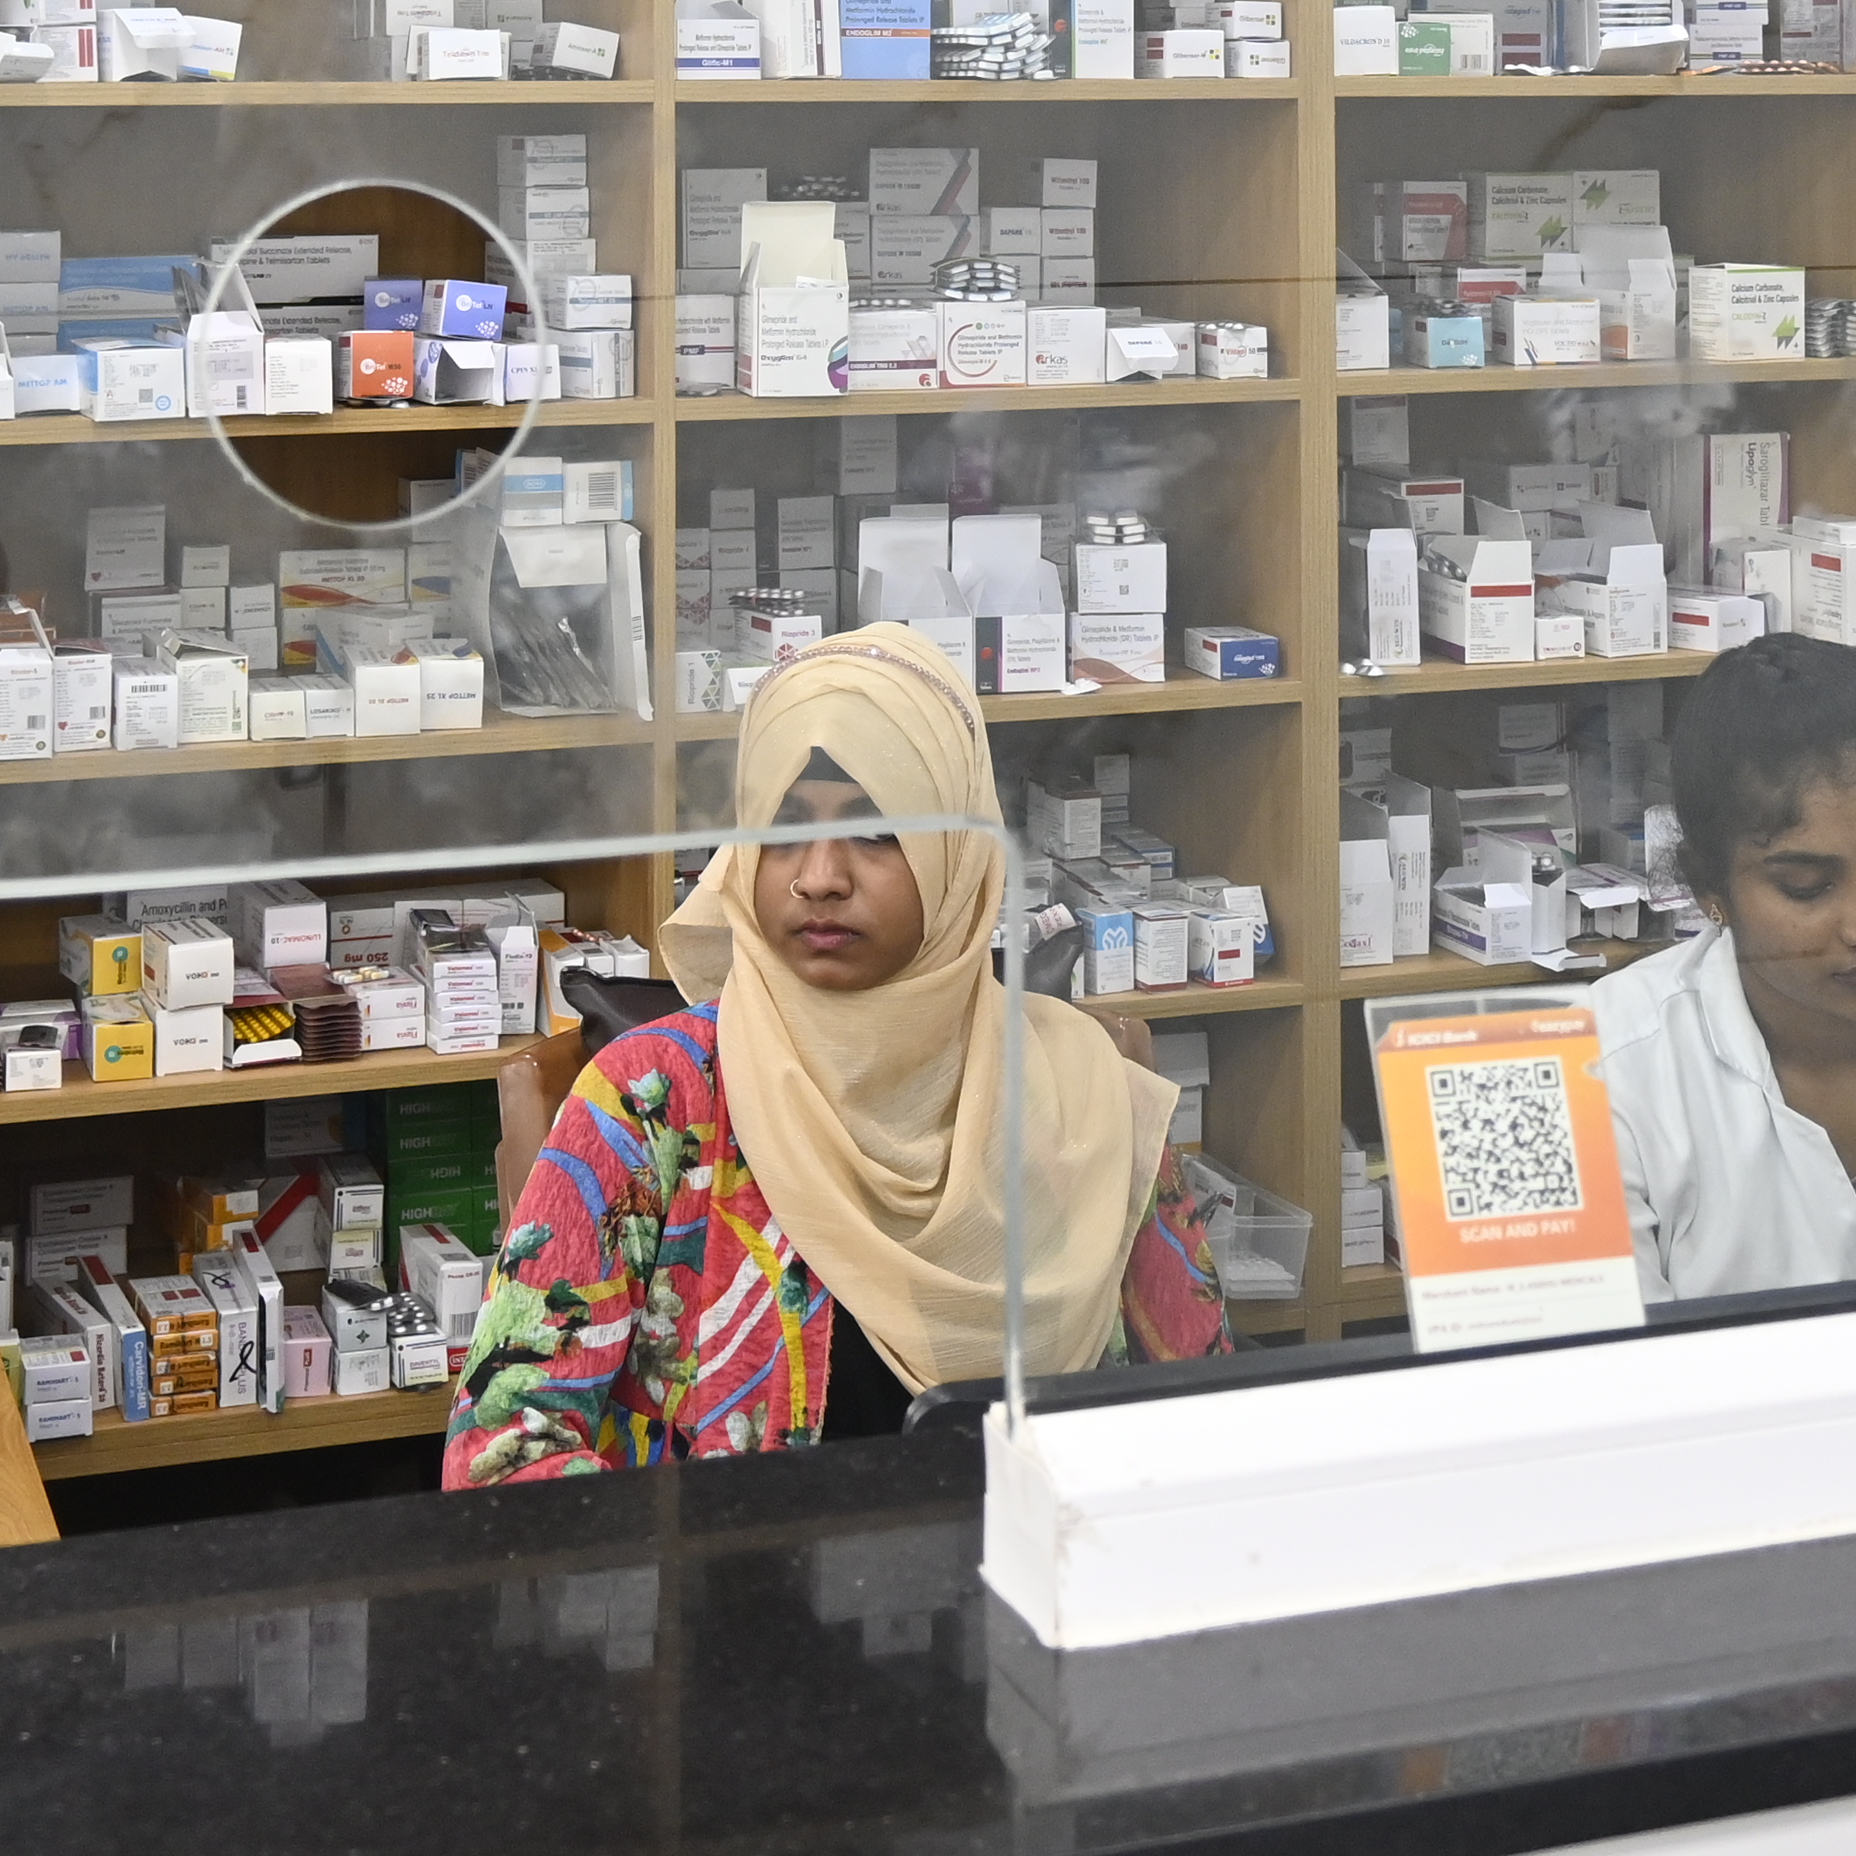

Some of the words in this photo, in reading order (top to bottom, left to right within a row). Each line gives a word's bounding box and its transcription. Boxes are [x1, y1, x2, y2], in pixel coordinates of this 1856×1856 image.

[876, 6, 915, 14] Hydrochloride
[846, 16, 874, 24] Prolonged
[1492, 186, 1516, 194] Calcium
[1518, 186, 1549, 195] Carbonate,
[1492, 197, 1518, 205] Calcitriol
[1539, 196, 1567, 205] Capsules
[259, 247, 291, 256] Succinate
[293, 247, 323, 256] Extended
[326, 246, 352, 256] Release,
[266, 256, 303, 265] Telmisartan
[306, 256, 330, 265] Tablets
[1732, 284, 1754, 292] Calcium
[1755, 283, 1784, 293] Carbonate,
[1731, 295, 1756, 304] Calcitriol
[1764, 295, 1775, 303] Zinc
[1776, 294, 1800, 304] Capsules
[283, 316, 313, 325] Extended
[315, 316, 342, 325] Release,
[762, 316, 786, 325] Glimepiride
[295, 326, 318, 335] Tablets
[785, 327, 816, 337] Hydrochloride
[957, 334, 986, 342] Glimepiride
[786, 340, 803, 348] Release
[957, 342, 991, 350] Hydrochloride
[993, 342, 1019, 350] Prolonged
[18, 380, 51, 388] METTOP
[1759, 442, 1771, 502] Saroglitazar
[1081, 625, 1111, 633] Glimepiride
[782, 630, 808, 638] Riopride
[1081, 635, 1115, 643] Hydrochloride
[1133, 634, 1152, 642] Tablets
[688, 670, 696, 704] Riopride
[427, 693, 436, 701] 25
[438, 693, 448, 701] XL
[449, 692, 476, 700] METTOP
[141, 900, 196, 917] Amoxycillin
[198, 900, 216, 912] and
[271, 932, 322, 945] LUNOMAC-10
[344, 953, 363, 963] mg
[366, 952, 388, 963] 250
[1447, 1031, 1479, 1043] Bank
[1459, 1226, 1502, 1244] SCAN
[1505, 1224, 1538, 1240] AND
[1540, 1220, 1576, 1238] PAY!
[1421, 1287, 1467, 1302] Merchant
[95, 1334, 105, 1370] Nicardia
[134, 1342, 147, 1410] Carvidon-MR
[96, 1371, 105, 1394] Retard
